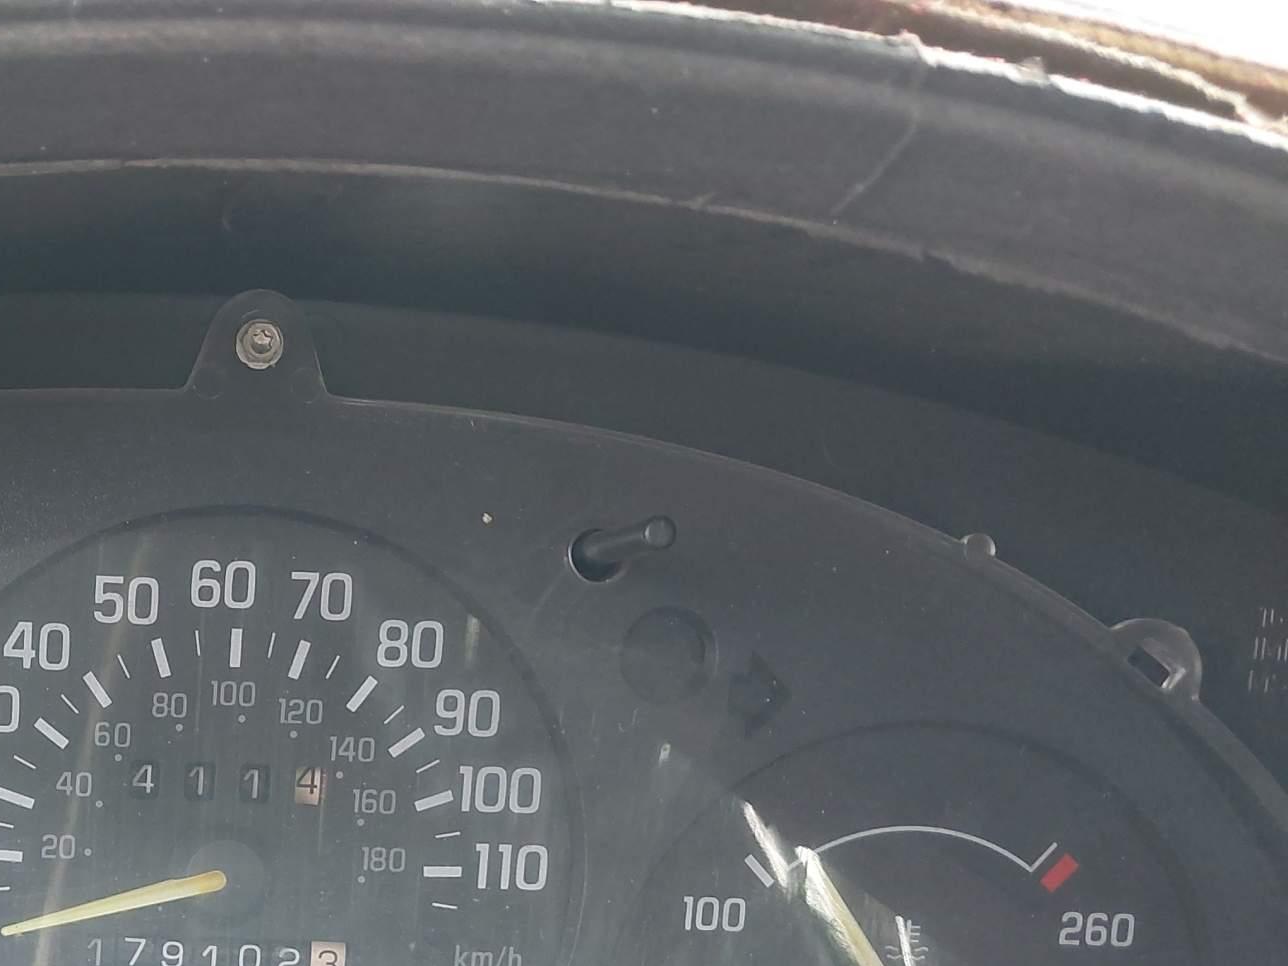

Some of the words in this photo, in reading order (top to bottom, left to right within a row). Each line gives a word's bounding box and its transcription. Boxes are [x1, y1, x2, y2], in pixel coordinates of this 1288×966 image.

[94, 576, 159, 625] 50
[191, 560, 255, 609] 60
[291, 571, 352, 622] 70
[4, 621, 70, 671] 40
[376, 620, 443, 669] 80
[152, 692, 187, 718] 80
[212, 681, 256, 706] 100
[279, 698, 324, 724] 120
[434, 690, 499, 738] 90
[95, 723, 130, 747] 60
[329, 737, 374, 763] 140
[56, 772, 92, 797] 40
[353, 790, 396, 815] 160
[459, 766, 542, 814] 100
[41, 835, 75, 860] 20
[362, 847, 406, 873] 180
[475, 844, 548, 891] 110
[683, 896, 746, 932] 100
[1059, 912, 1136, 948] 260
